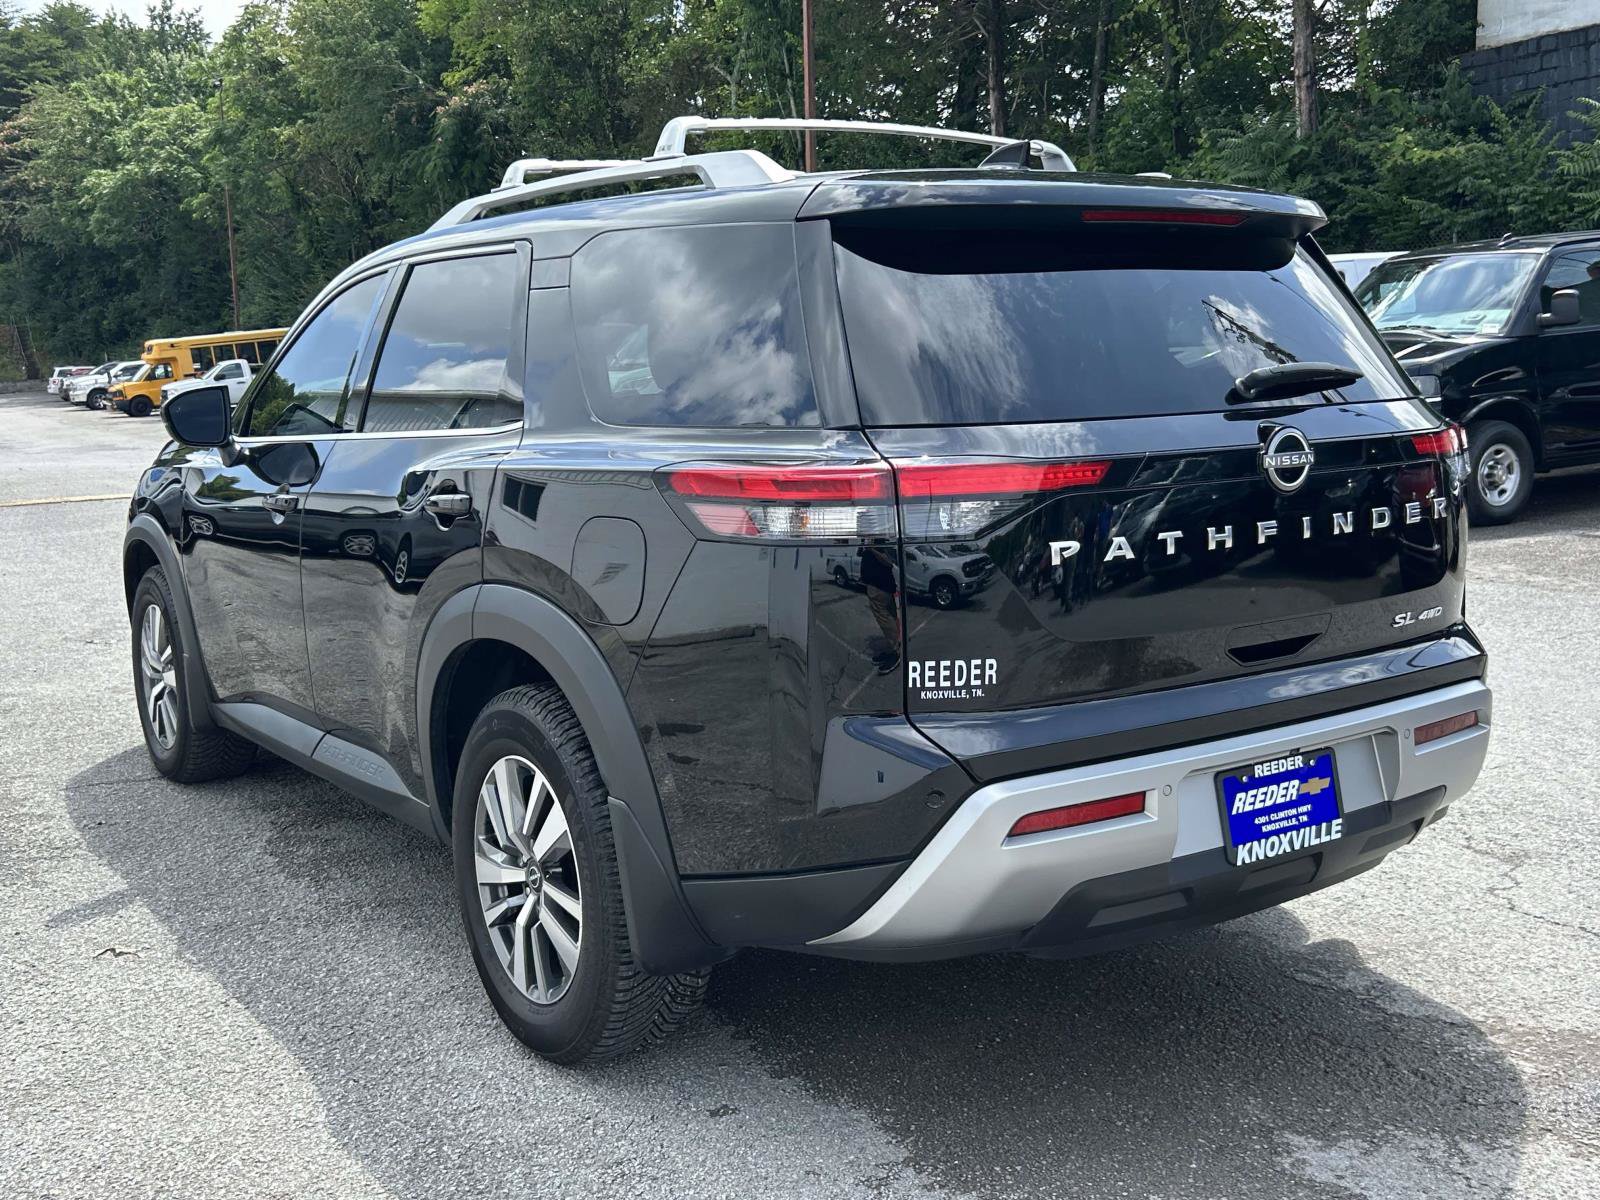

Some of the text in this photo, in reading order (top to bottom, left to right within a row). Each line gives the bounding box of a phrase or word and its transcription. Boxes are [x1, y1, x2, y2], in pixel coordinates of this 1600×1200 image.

[1265, 453, 1314, 466] NISSAN
[1049, 497, 1448, 566] PATHFINDER
[1392, 606, 1443, 628] SL 4WD
[908, 658, 998, 688] REEDER
[920, 688, 985, 699] KNOXVILLE, TN.
[1254, 755, 1303, 778] REEDER
[1232, 779, 1300, 815] REEDER
[1254, 804, 1311, 825] 4301 CLINTON HWY
[1262, 815, 1307, 832] KNOXVILLE, TN
[1236, 818, 1342, 866] KNOXVILLE
